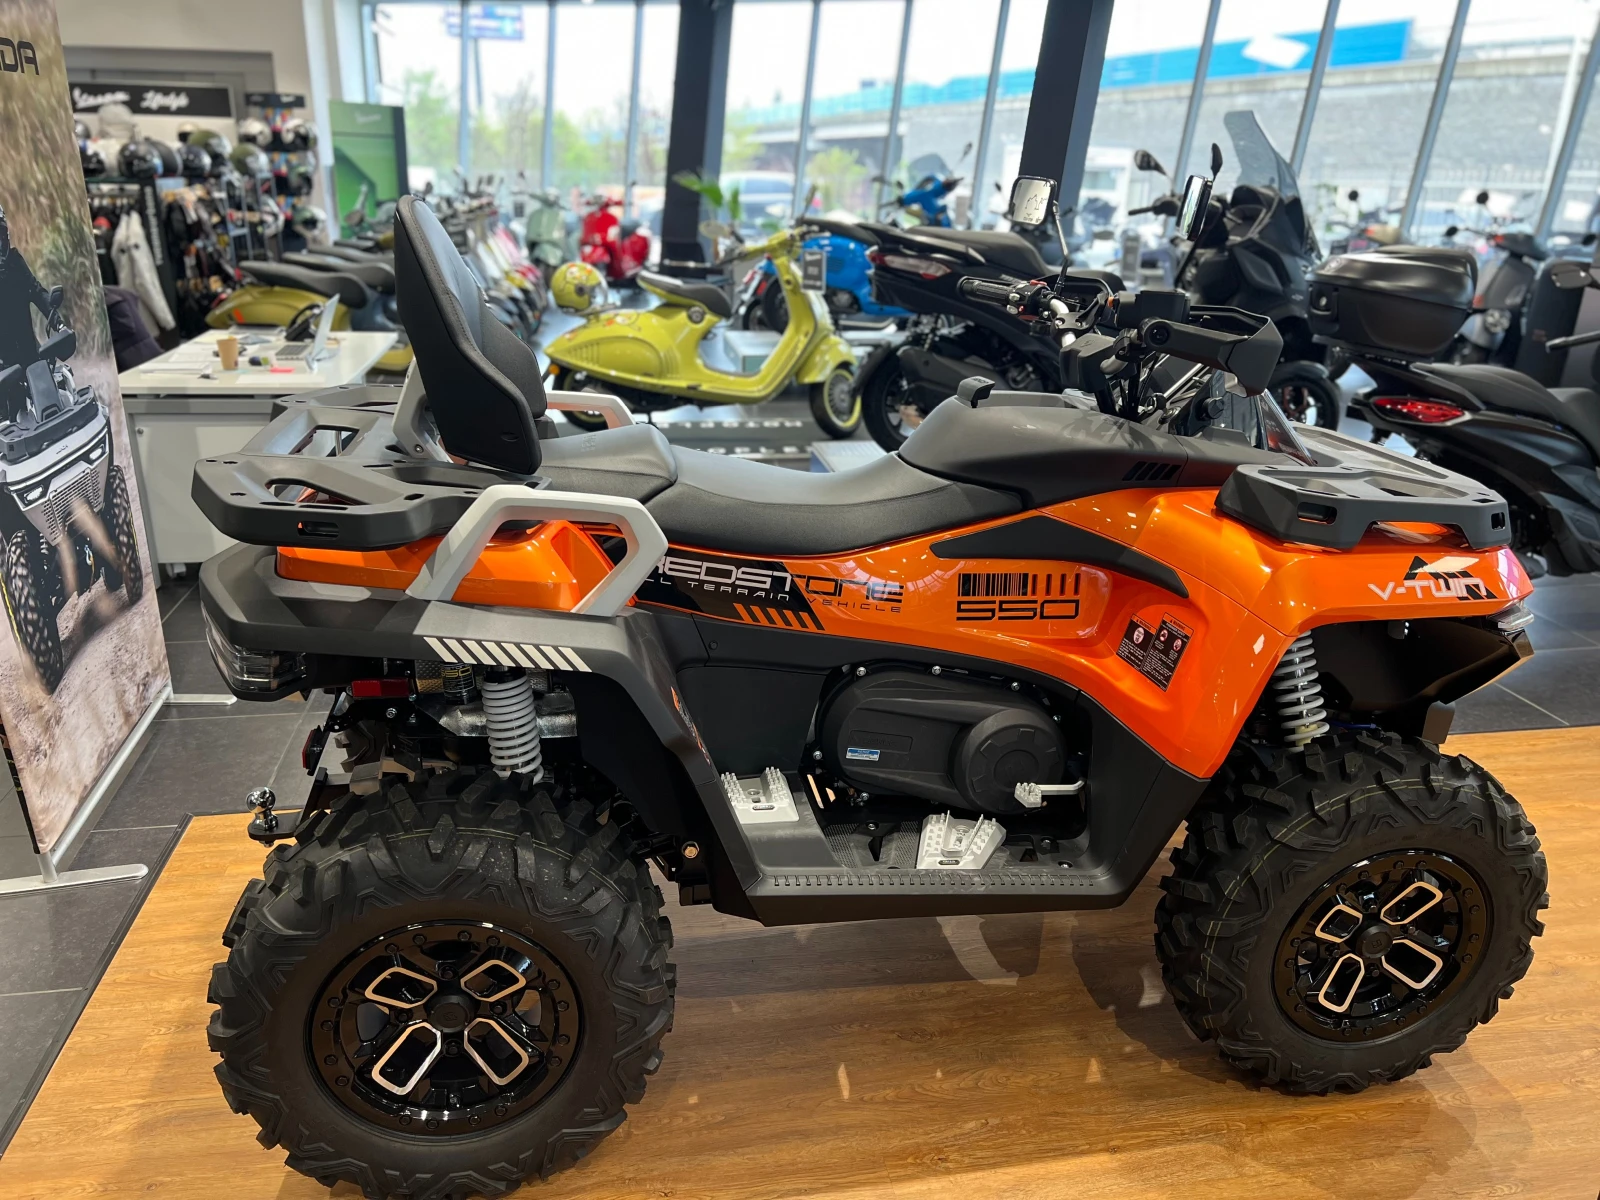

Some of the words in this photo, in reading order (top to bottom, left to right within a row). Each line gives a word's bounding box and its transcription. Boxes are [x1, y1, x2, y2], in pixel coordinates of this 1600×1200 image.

[0, 36, 40, 76] DA
[688, 581, 790, 601] TERRAIN
[807, 597, 902, 613] VEHICLE
[1367, 577, 1488, 601] V-TWIN
[955, 599, 1080, 621] 550
